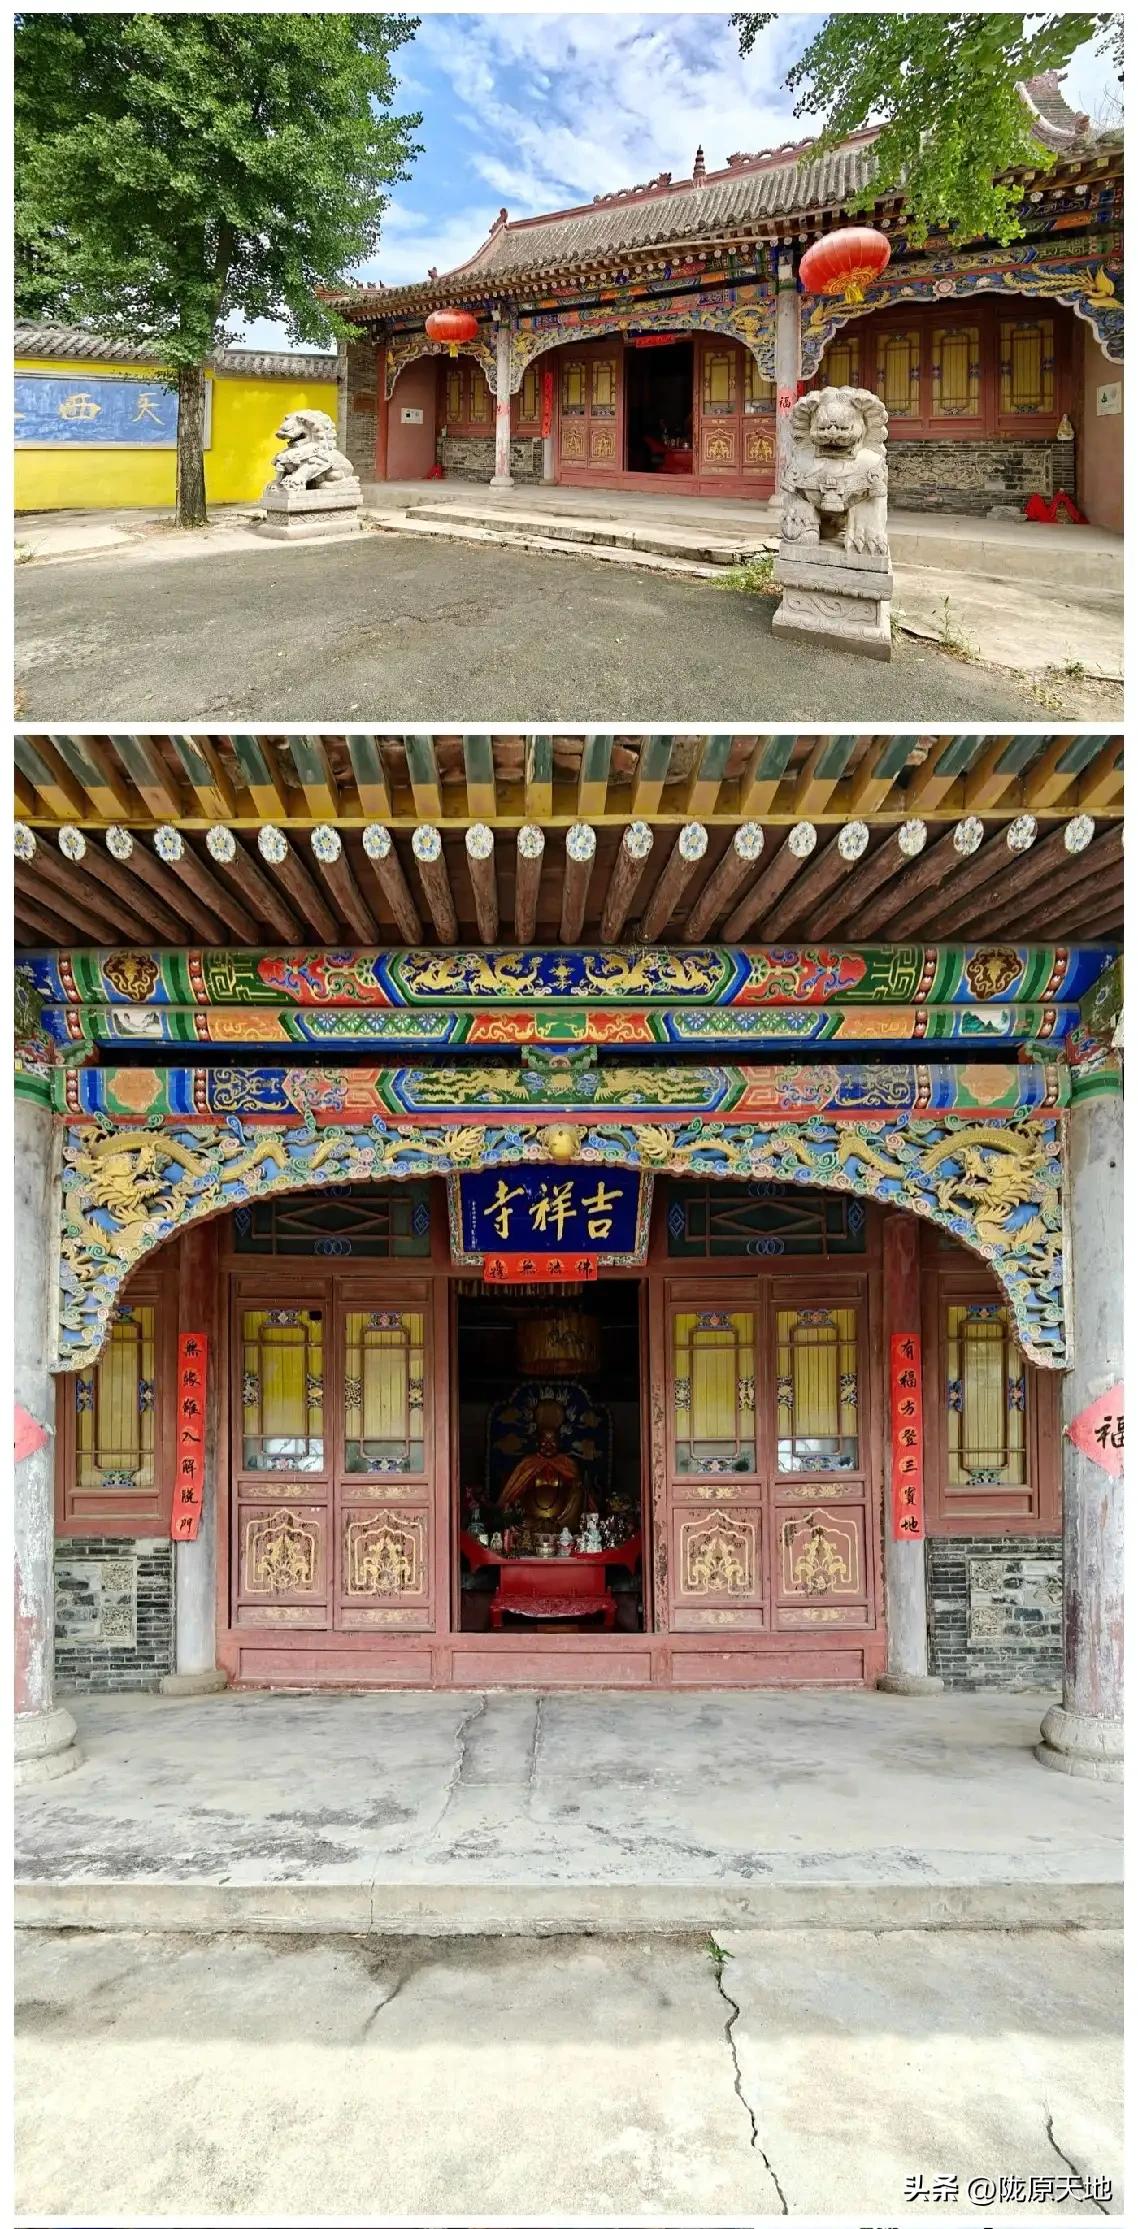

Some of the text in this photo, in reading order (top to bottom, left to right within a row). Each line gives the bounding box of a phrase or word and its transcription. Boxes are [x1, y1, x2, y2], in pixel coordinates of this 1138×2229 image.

[779, 396, 791, 408] 福
[484, 1180, 624, 1241] 吉祥寺
[1094, 1415, 1124, 1449] 福
